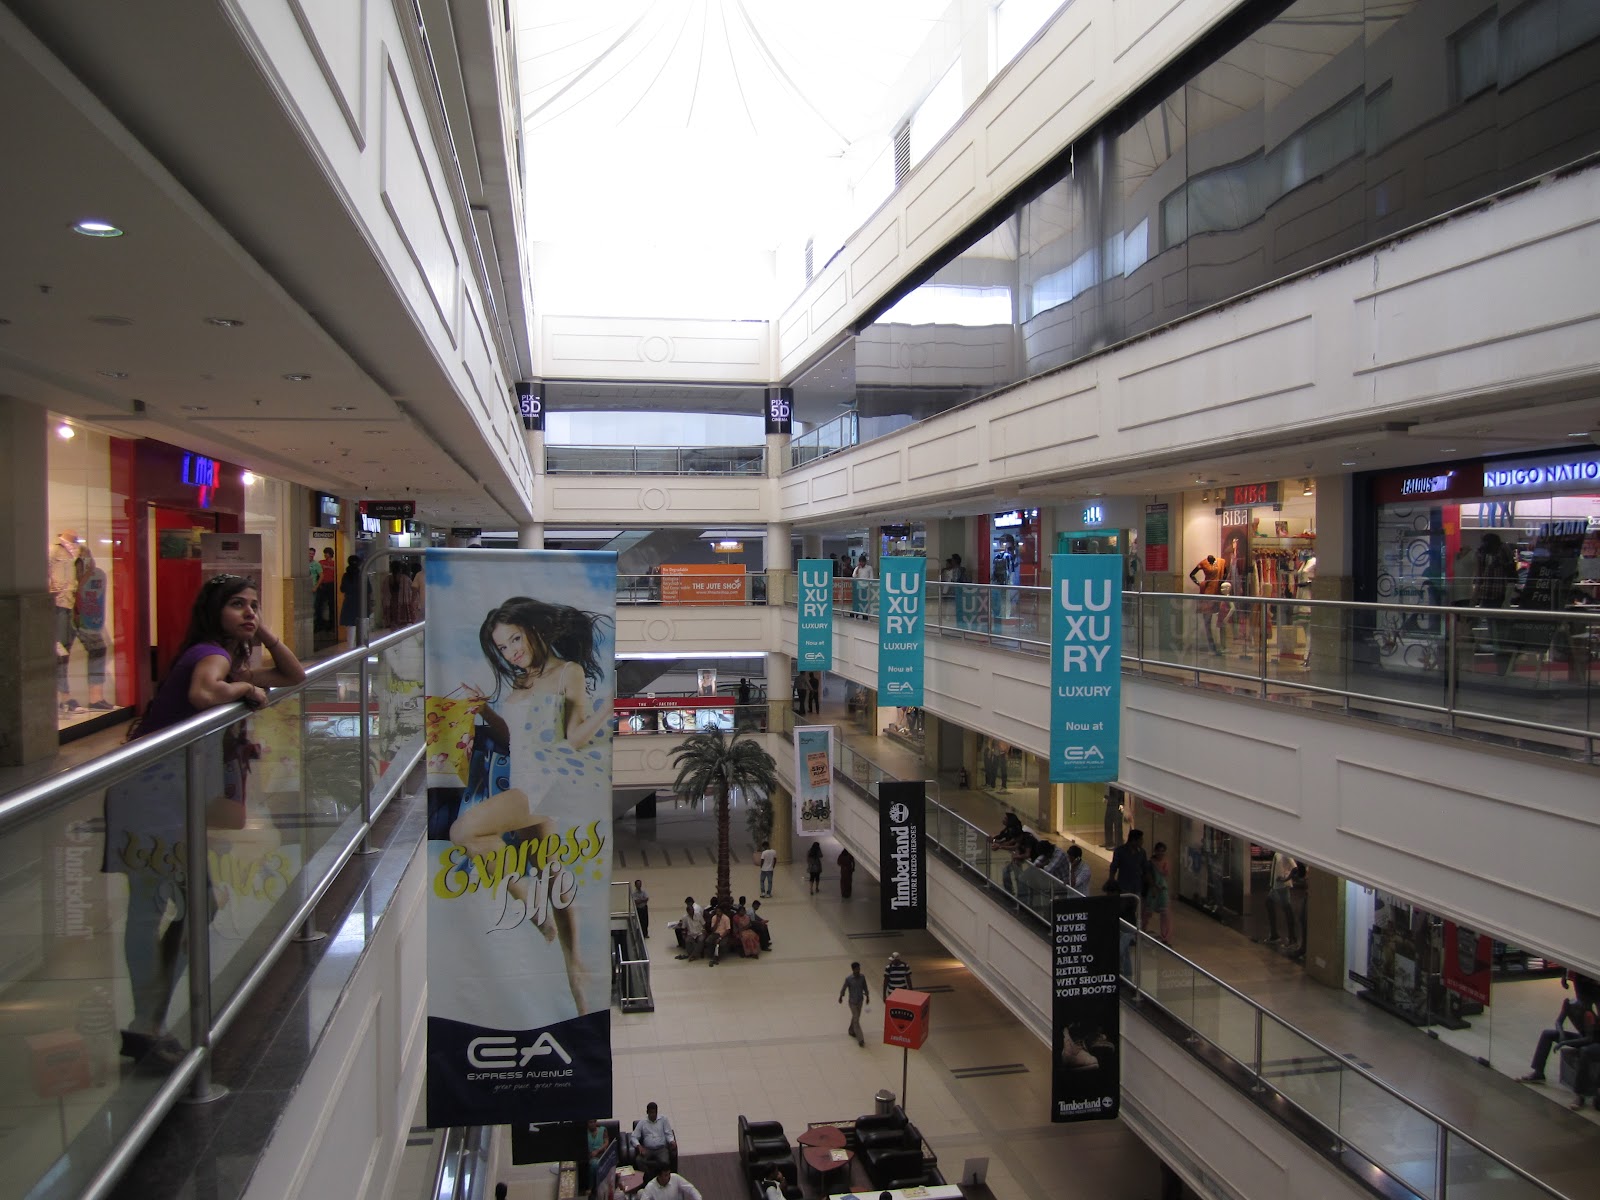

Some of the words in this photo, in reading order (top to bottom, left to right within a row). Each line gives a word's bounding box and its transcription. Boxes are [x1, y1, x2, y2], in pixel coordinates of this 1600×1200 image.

[521, 400, 541, 413] 5D
[771, 405, 790, 418] 5D
[1233, 483, 1267, 505] BIBA
[1222, 509, 1248, 526] BIBA
[802, 571, 828, 587] LU
[885, 572, 919, 594] LU
[805, 589, 828, 602] XU
[1061, 579, 1112, 611] LU
[804, 603, 828, 617] RY
[887, 596, 918, 614] XU
[886, 616, 918, 634] RY
[1064, 615, 1111, 641] XU
[883, 642, 918, 650] LUXURY
[1063, 645, 1112, 672] RY
[888, 665, 904, 673] Now
[887, 681, 914, 692] EA
[1058, 686, 1112, 697] LUXURY
[1065, 721, 1089, 731] Now
[1092, 721, 1103, 731] at
[1064, 745, 1104, 760] EA
[433, 821, 606, 900] Express
[890, 826, 910, 910] Timberland
[486, 860, 578, 935] Life
[1056, 912, 1088, 922] YOU'RE
[1056, 924, 1086, 933] NEVER
[1056, 934, 1087, 944] GOING
[1056, 946, 1069, 954] TO
[1070, 945, 1082, 953] BE
[1056, 956, 1078, 965] ABLE
[1081, 954, 1094, 963] TO
[1056, 977, 1077, 986] WHY
[1079, 974, 1116, 985] SHOULD
[1056, 988, 1080, 997] YOUR
[1082, 985, 1117, 995] BOOTS?
[467, 1032, 572, 1069] EA
[467, 1071, 523, 1080] EXPRESS
[526, 1069, 573, 1078] AVENUE
[1058, 1096, 1101, 1112] Timberland
